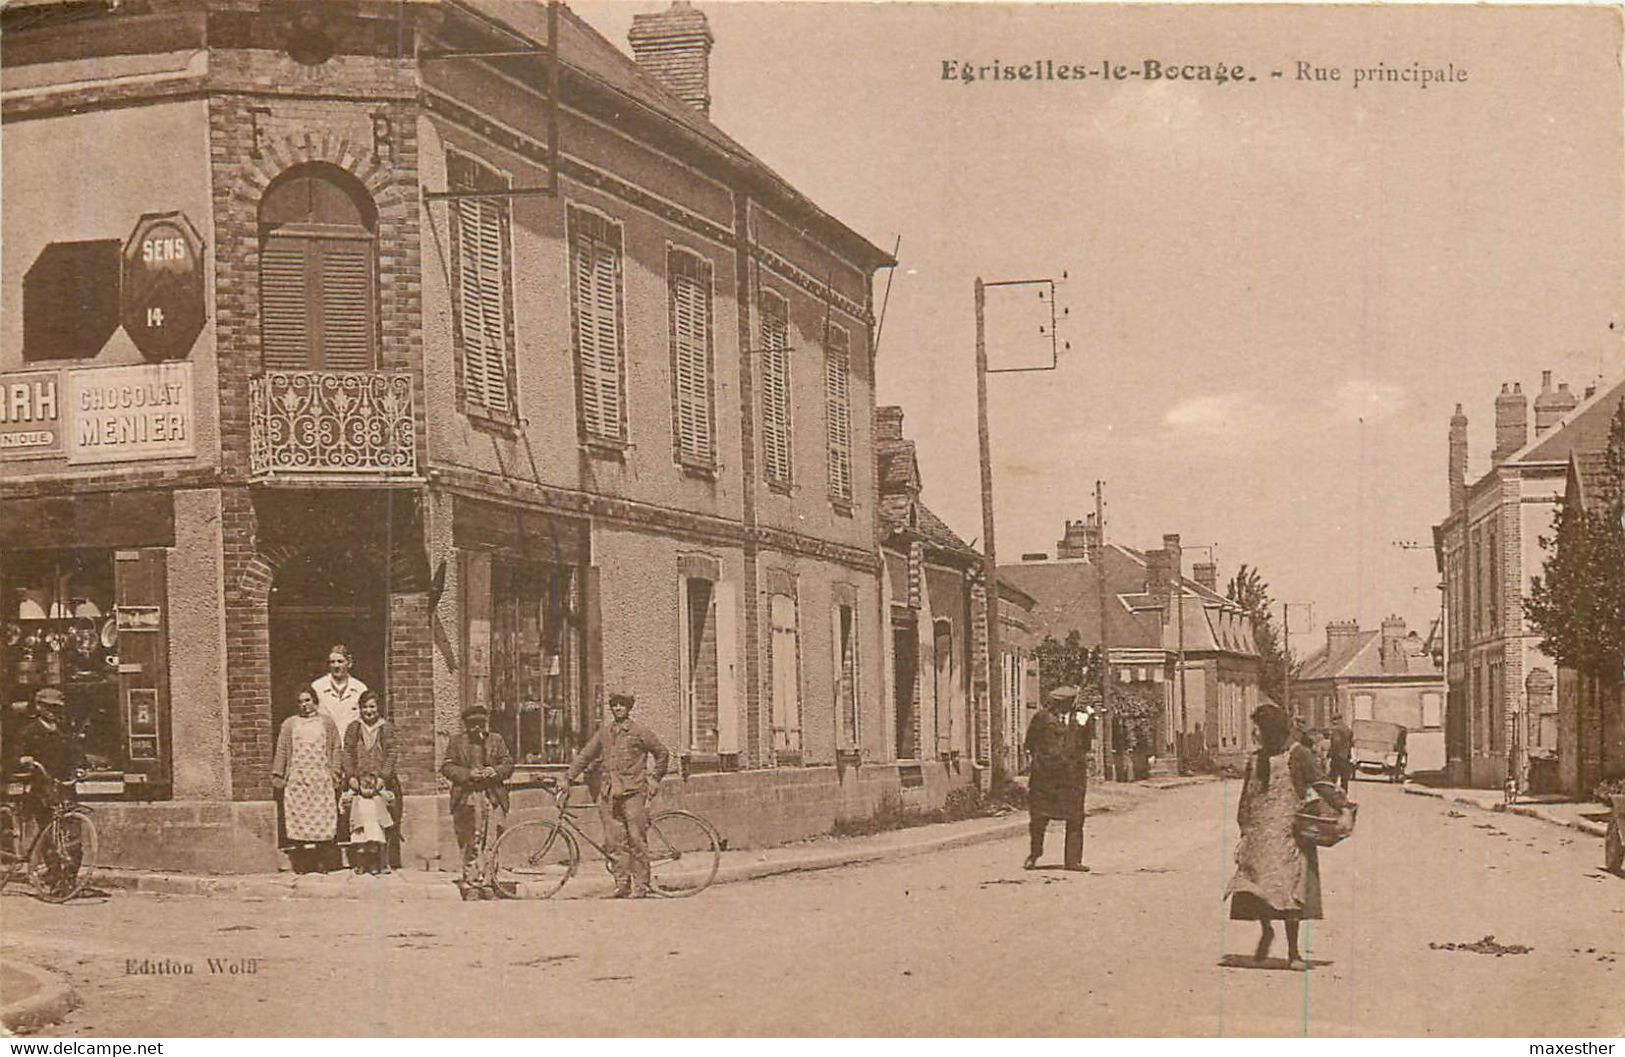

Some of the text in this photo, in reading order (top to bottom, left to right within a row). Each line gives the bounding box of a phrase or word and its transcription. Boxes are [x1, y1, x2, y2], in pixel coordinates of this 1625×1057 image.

[142, 238, 185, 262] SENS
[146, 307, 164, 327] 14
[80, 383, 182, 411] CHOCOLAT
[79, 413, 186, 446] MENIER
